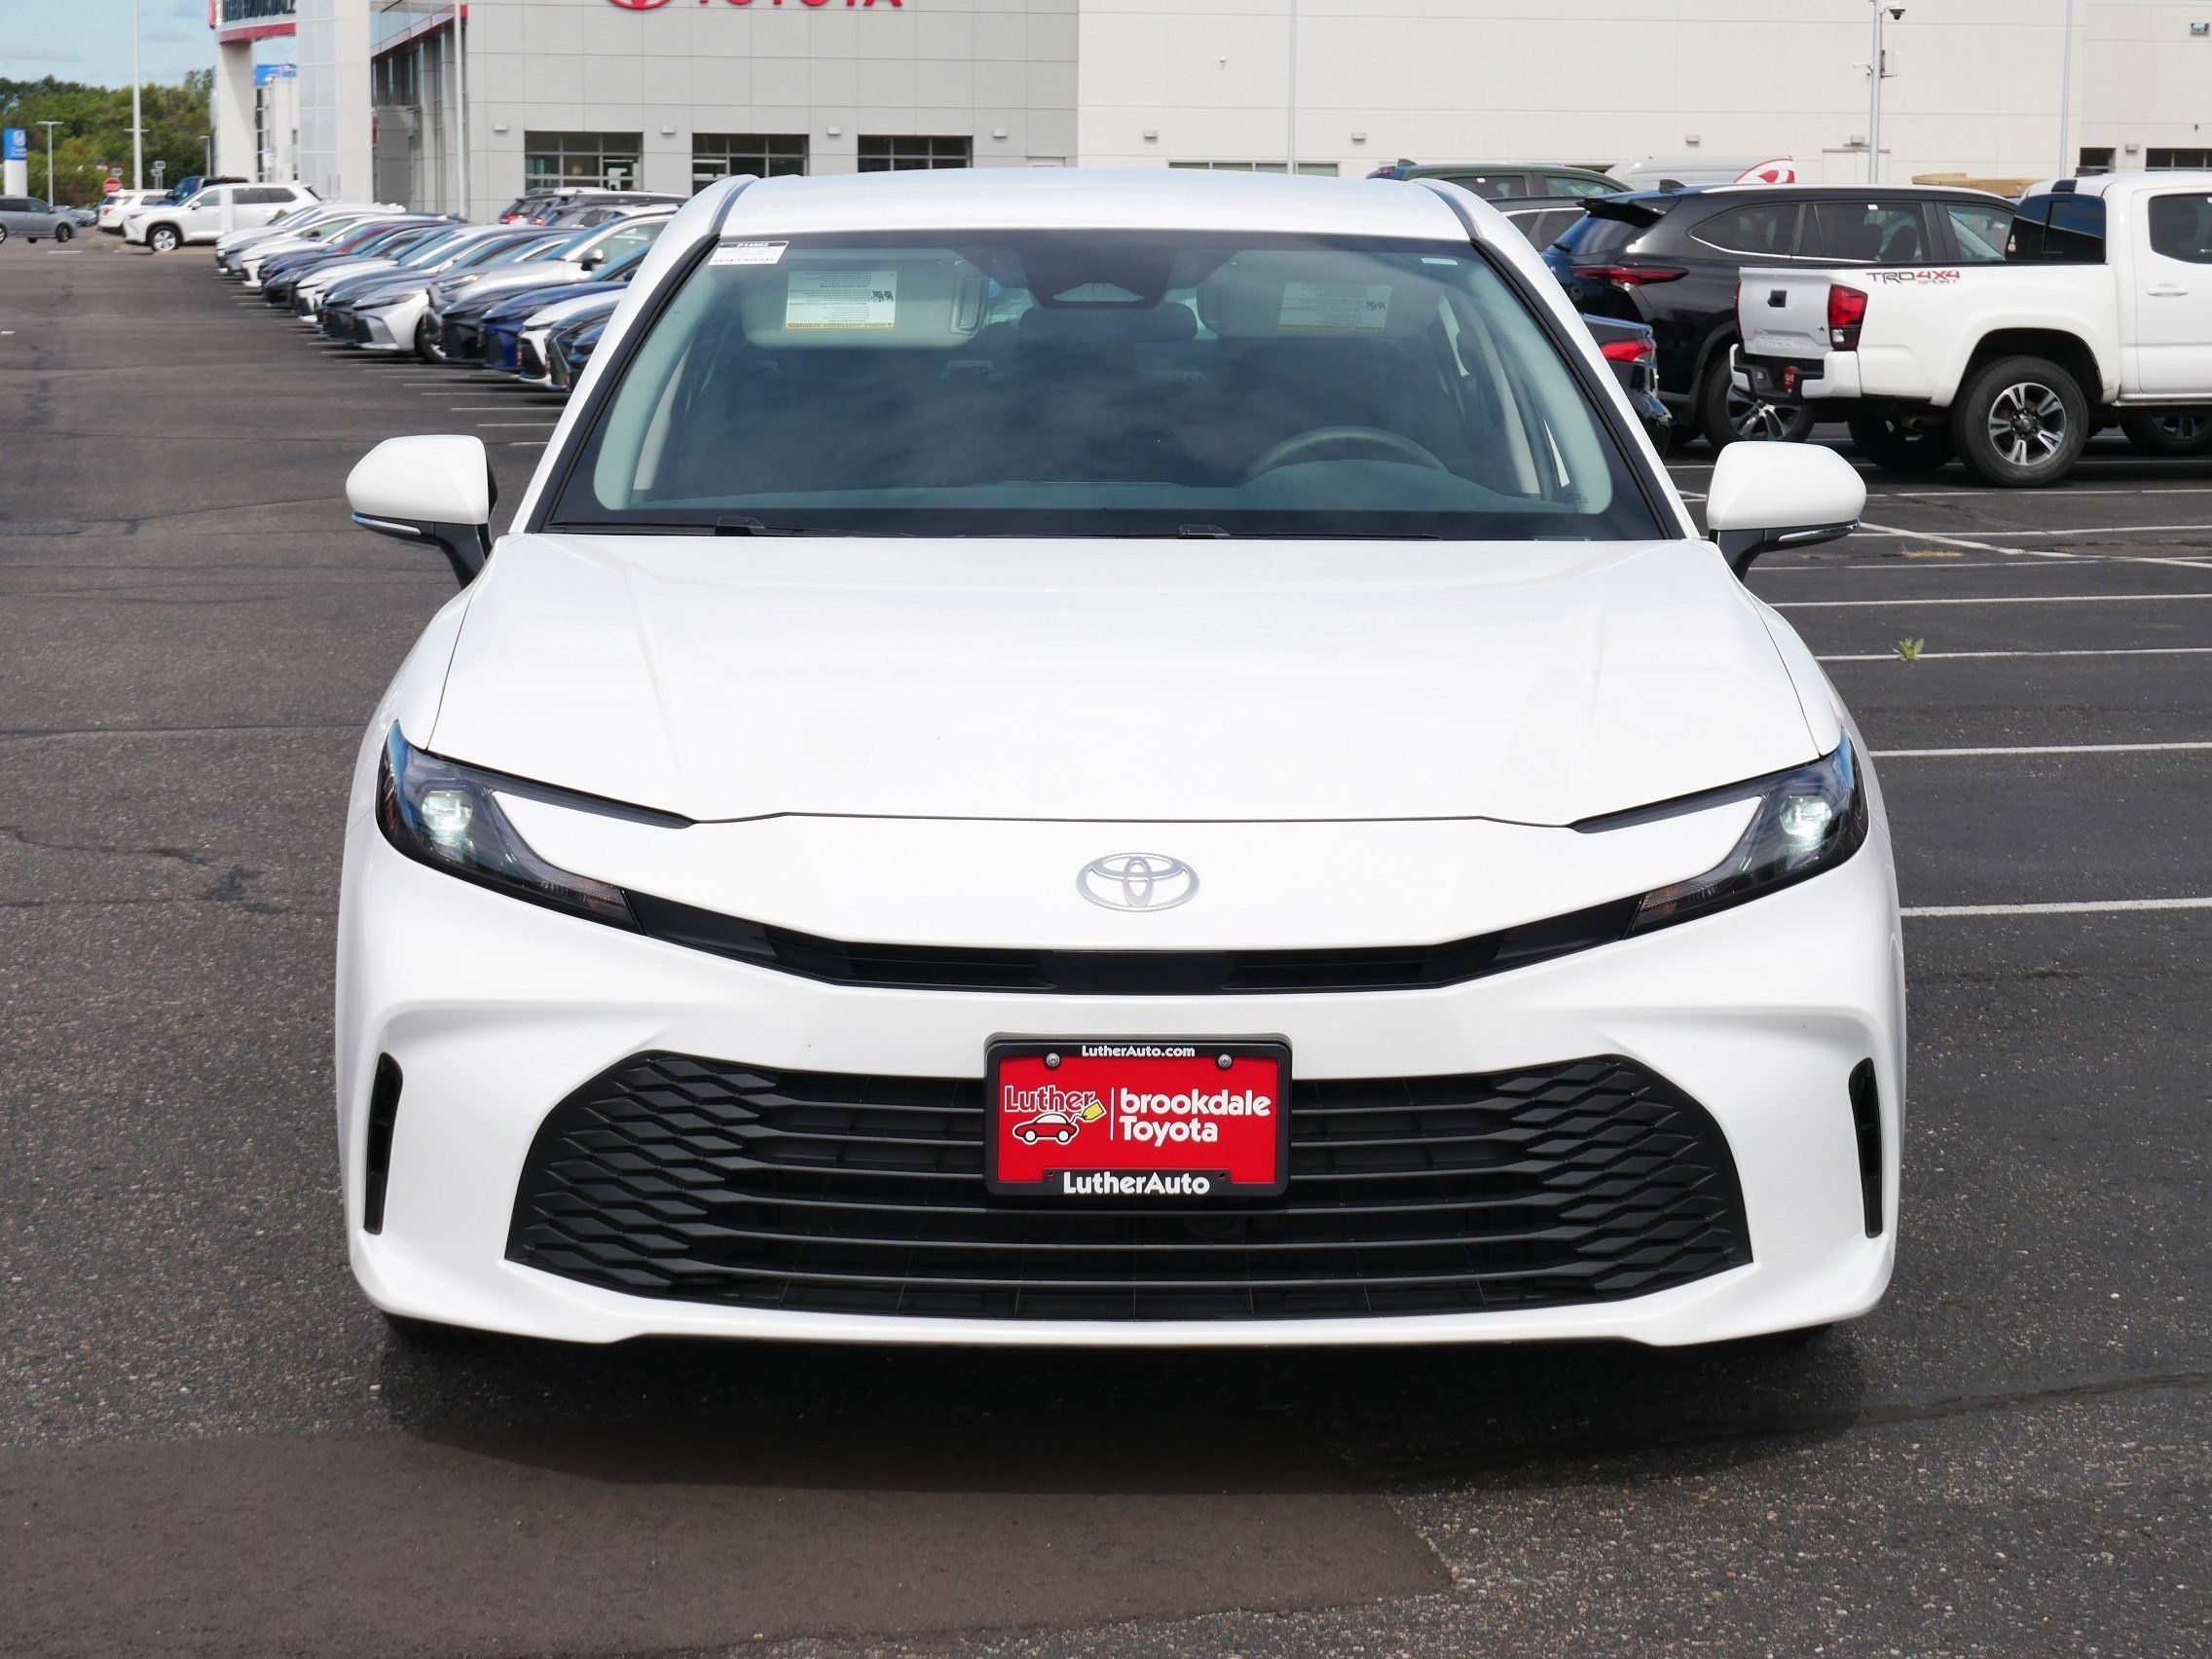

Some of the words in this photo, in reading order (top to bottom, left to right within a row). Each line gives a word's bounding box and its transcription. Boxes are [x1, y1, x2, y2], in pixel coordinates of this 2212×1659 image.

[1866, 272, 1915, 284] TRD
[1082, 1045, 1196, 1058] LutherAuto.com
[1004, 1084, 1096, 1113] Luther
[1120, 1088, 1272, 1117] brookdale
[1119, 1116, 1219, 1148] Toyota
[1063, 1171, 1211, 1196] LutherAuto
